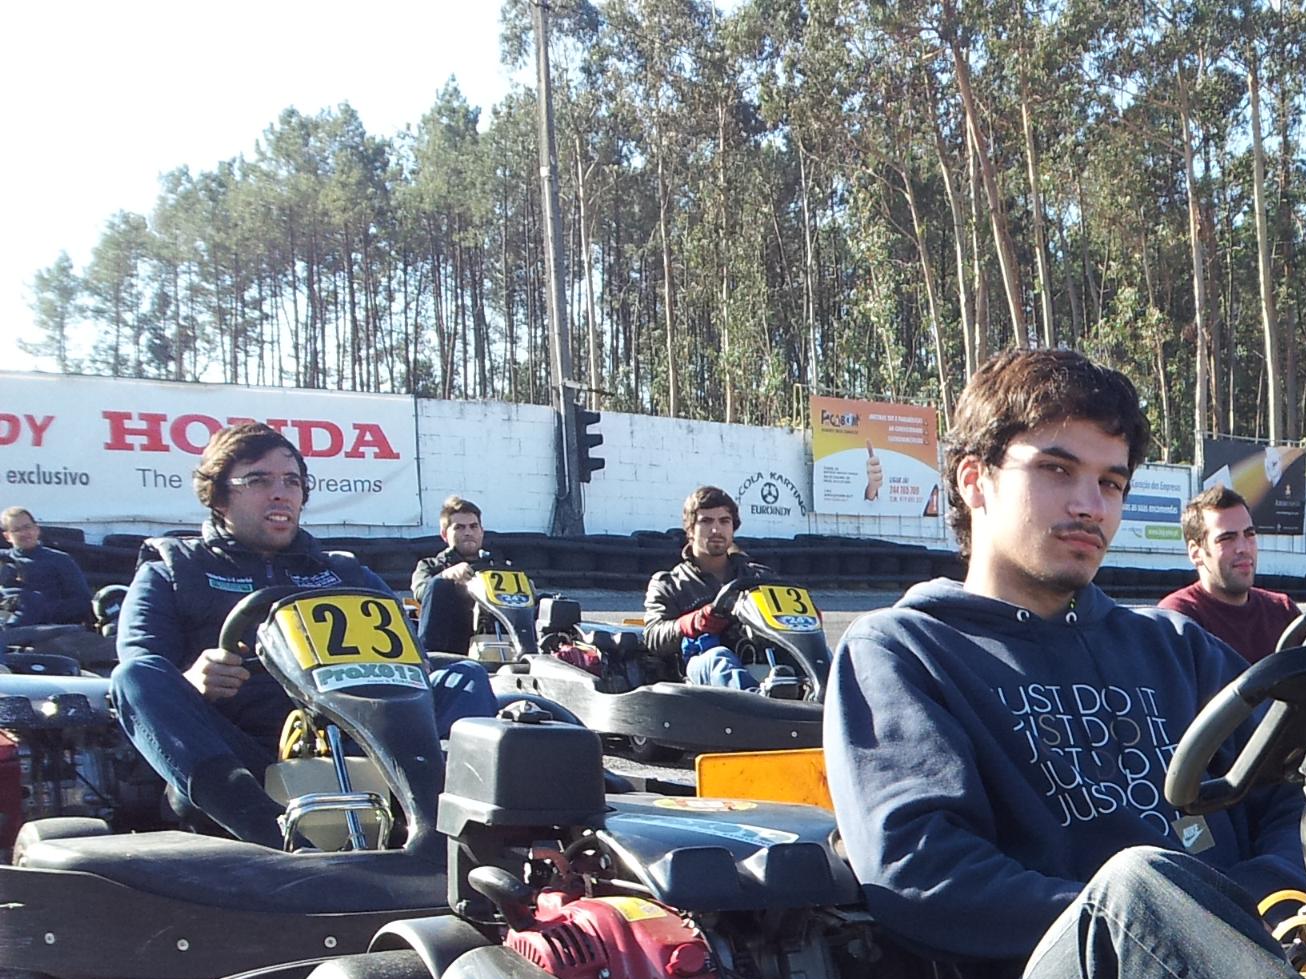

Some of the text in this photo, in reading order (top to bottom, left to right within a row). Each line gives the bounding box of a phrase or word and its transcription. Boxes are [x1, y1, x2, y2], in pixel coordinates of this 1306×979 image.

[6, 464, 90, 486] exclusivo
[136, 468, 182, 489] The
[751, 504, 791, 516] EUROINDY
[490, 572, 526, 594] 21
[768, 588, 808, 614] 13
[312, 600, 403, 659] 23
[1072, 684, 1132, 716] DO
[1136, 687, 1158, 717] IT
[1147, 716, 1169, 746] IT
